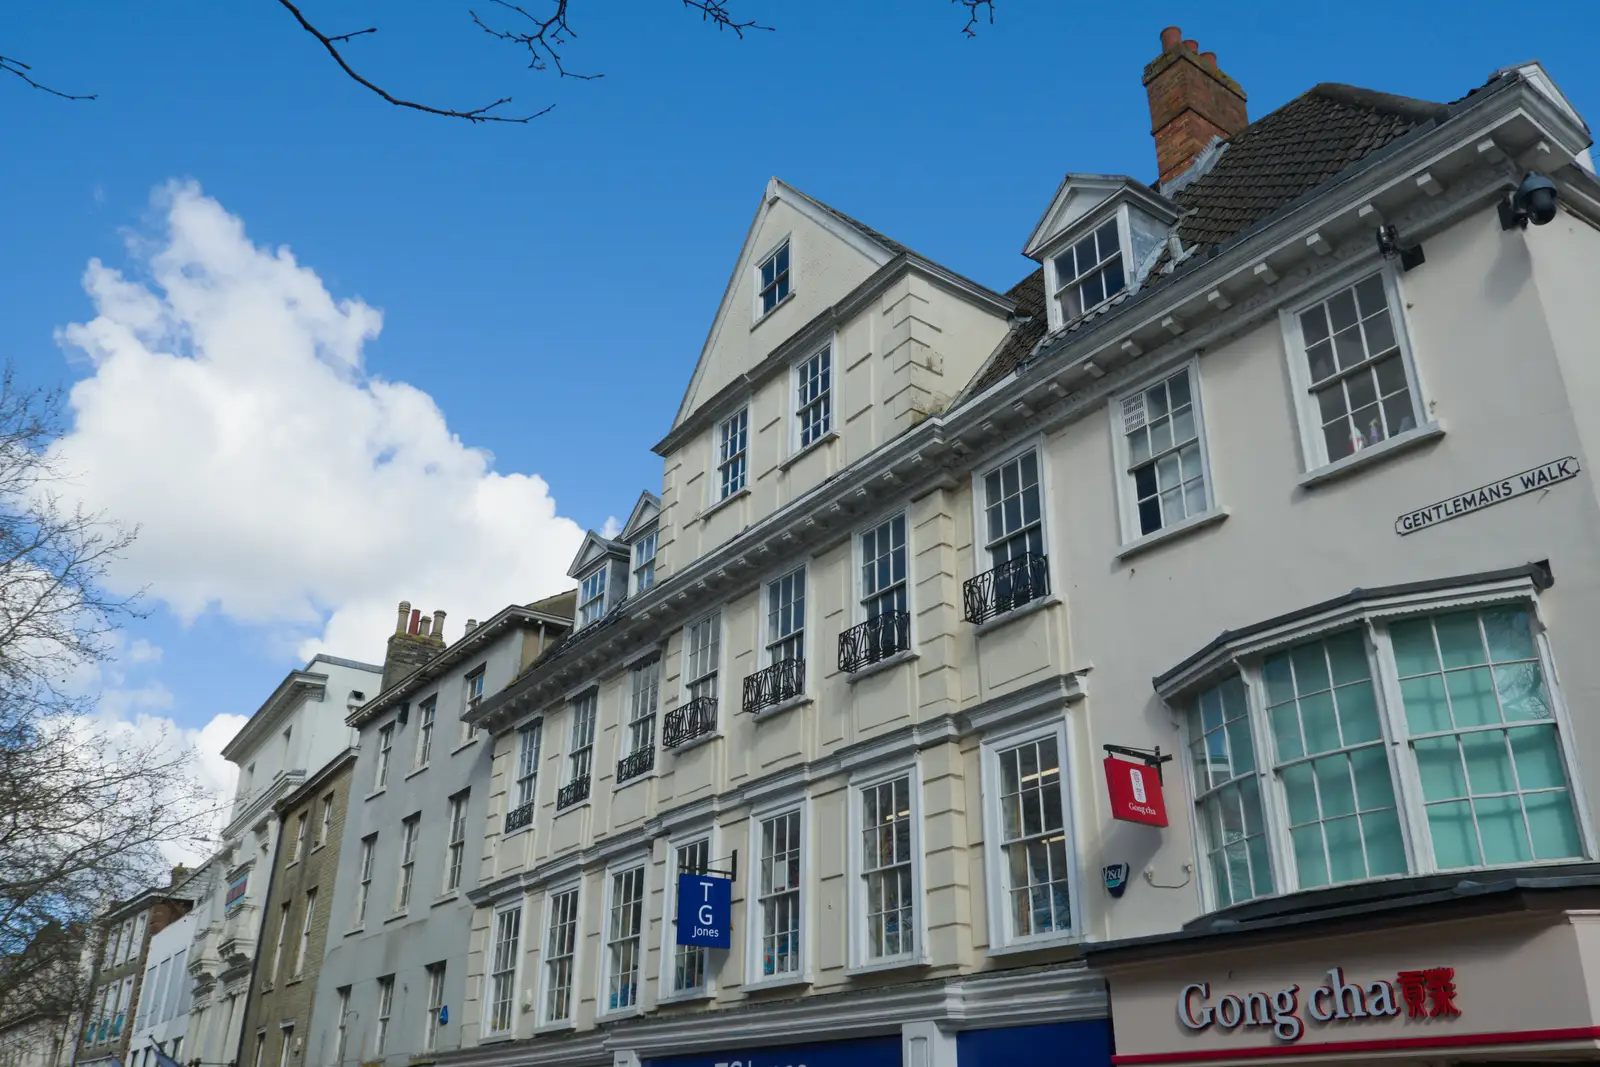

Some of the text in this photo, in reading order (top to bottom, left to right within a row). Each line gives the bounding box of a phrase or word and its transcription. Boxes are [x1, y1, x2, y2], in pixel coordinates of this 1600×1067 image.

[1403, 459, 1571, 530] GENTLEMANS WALK
[1128, 802, 1146, 815] Gong
[700, 882, 713, 902] T
[699, 905, 713, 925] G
[692, 926, 719, 938] Jones
[1178, 966, 1400, 1041] Gong cha
